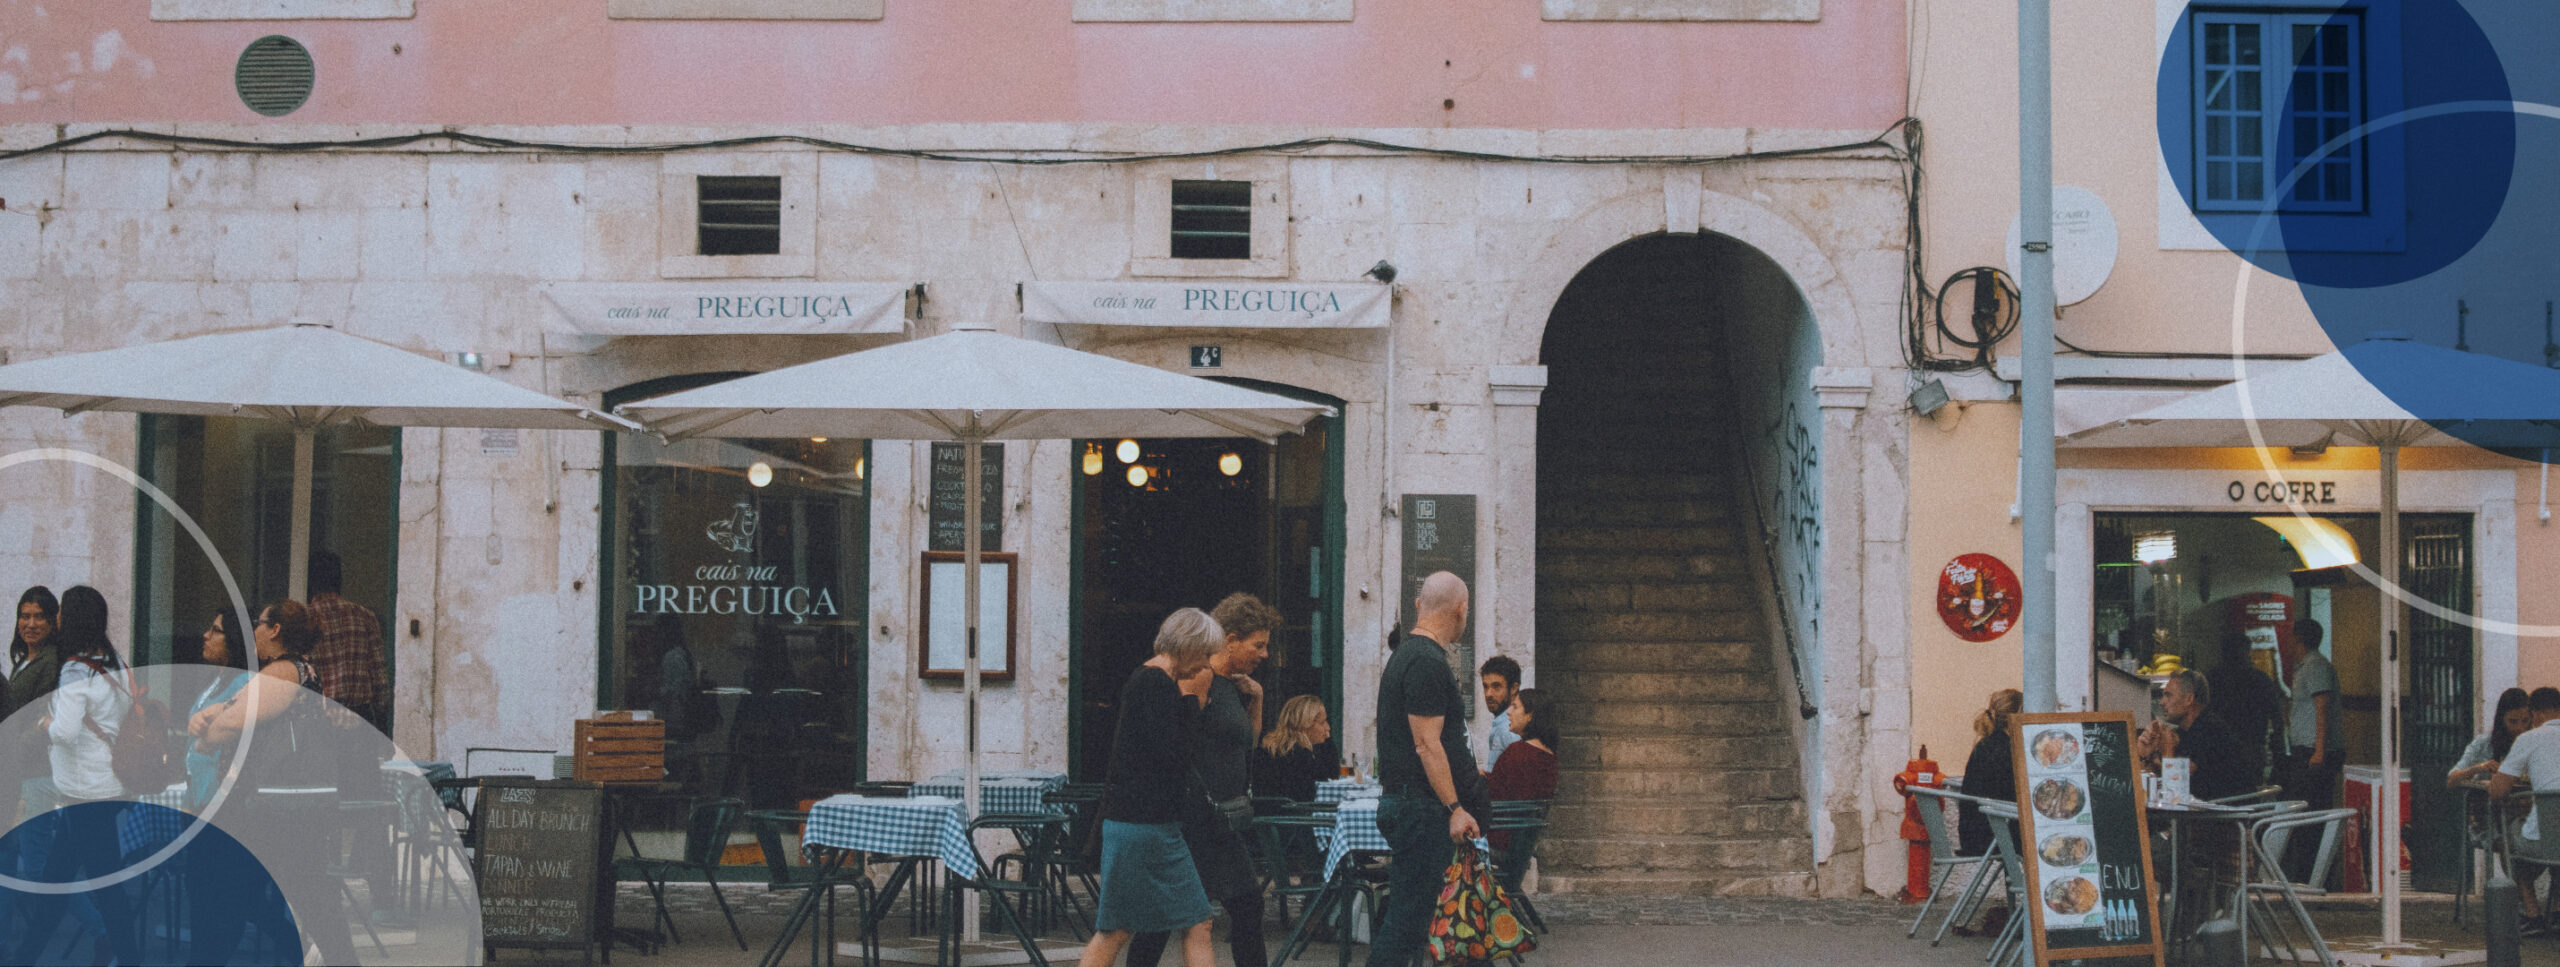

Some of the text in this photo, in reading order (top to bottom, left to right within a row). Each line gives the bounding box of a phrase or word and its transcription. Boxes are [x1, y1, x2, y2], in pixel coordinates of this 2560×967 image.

[608, 295, 853, 324] cais na PREGUIÇA
[1093, 288, 1341, 318] cais na PREGUIÇA
[2228, 480, 2336, 503] O COFRE
[696, 559, 778, 581] cais na
[634, 584, 838, 624] PREGUIÇA
[487, 808, 591, 832] ALL DAY BRUNCH
